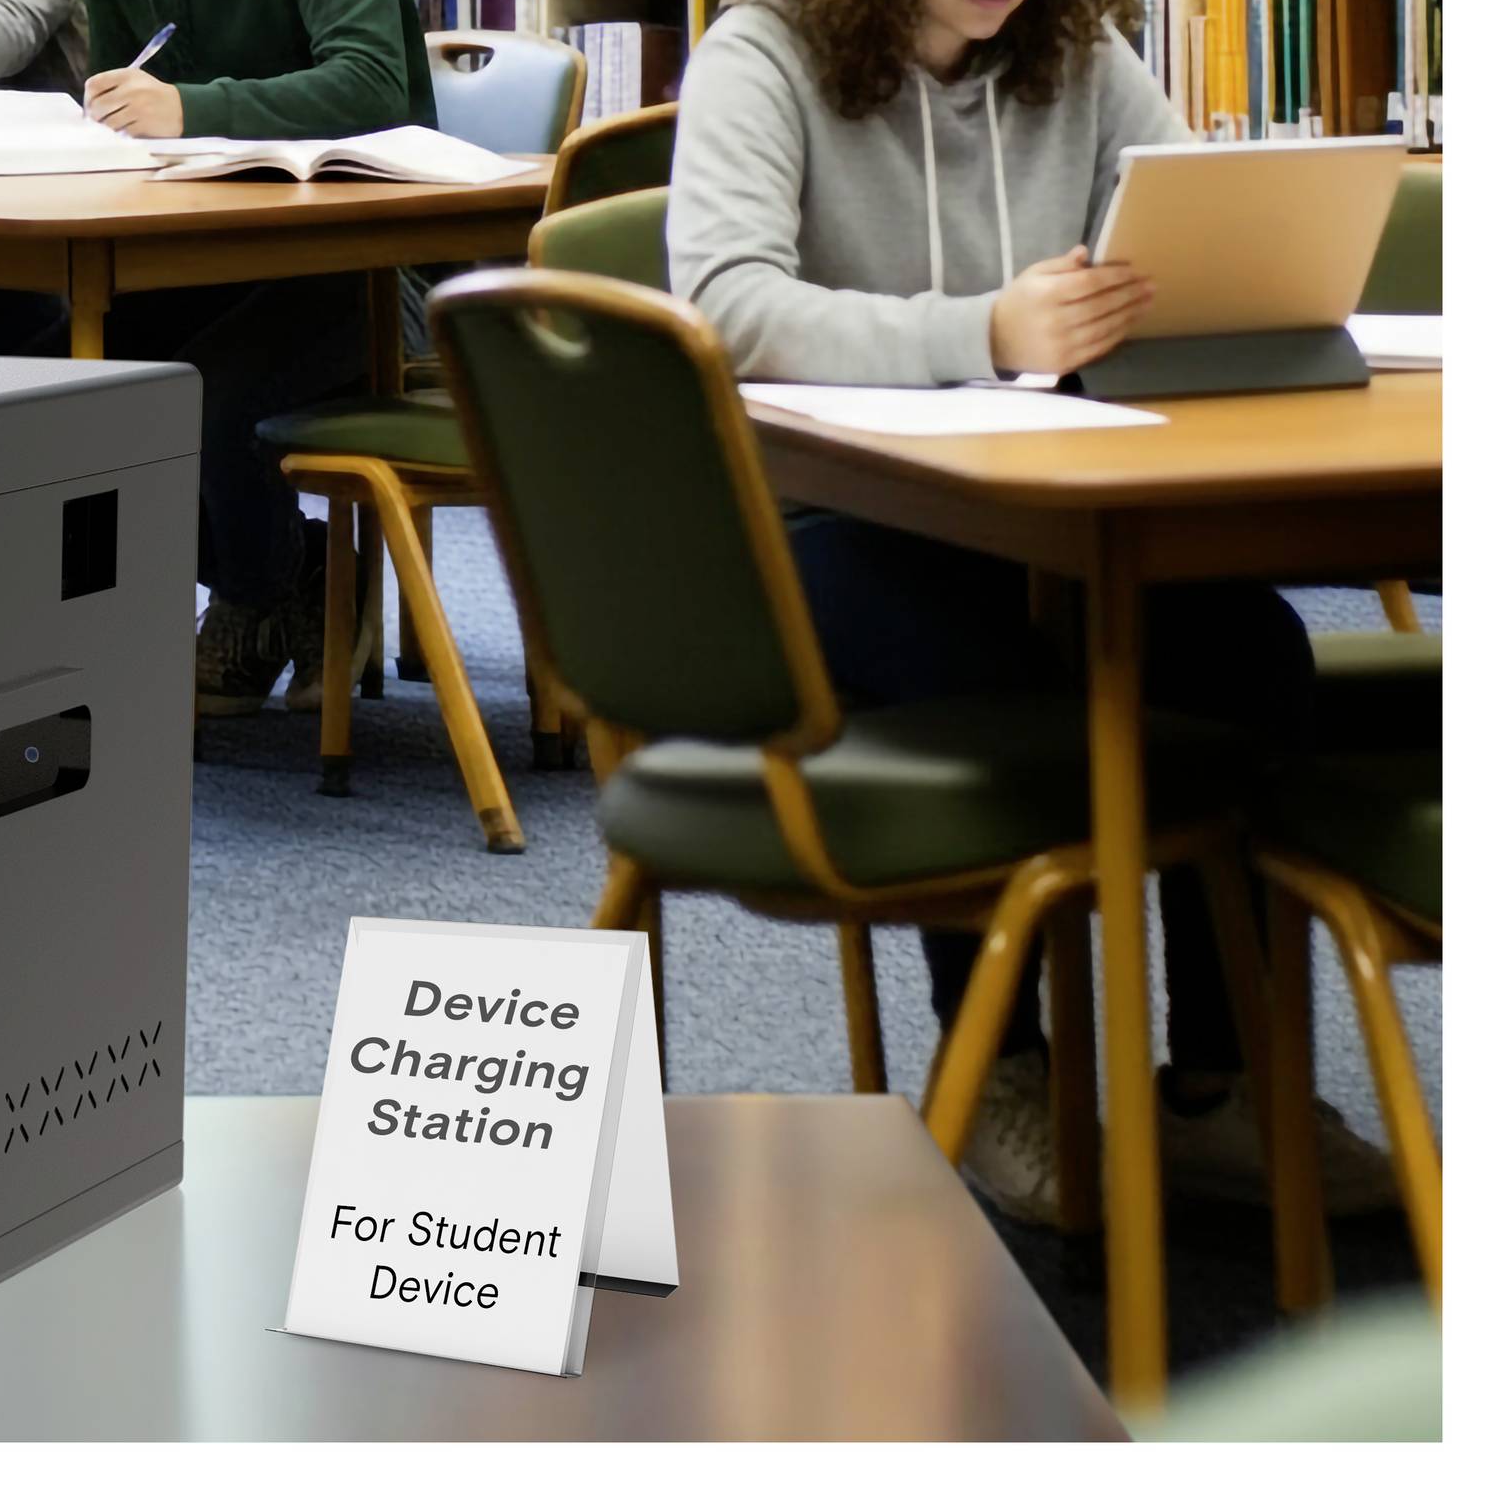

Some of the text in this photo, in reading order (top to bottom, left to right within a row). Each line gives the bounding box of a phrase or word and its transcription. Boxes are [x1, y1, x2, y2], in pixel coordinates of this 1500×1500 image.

[404, 980, 580, 1030] Device
[350, 1036, 589, 1101] Charging
[367, 1099, 554, 1150] Station
[330, 1205, 562, 1258] For Student
[369, 1264, 499, 1310] Device
